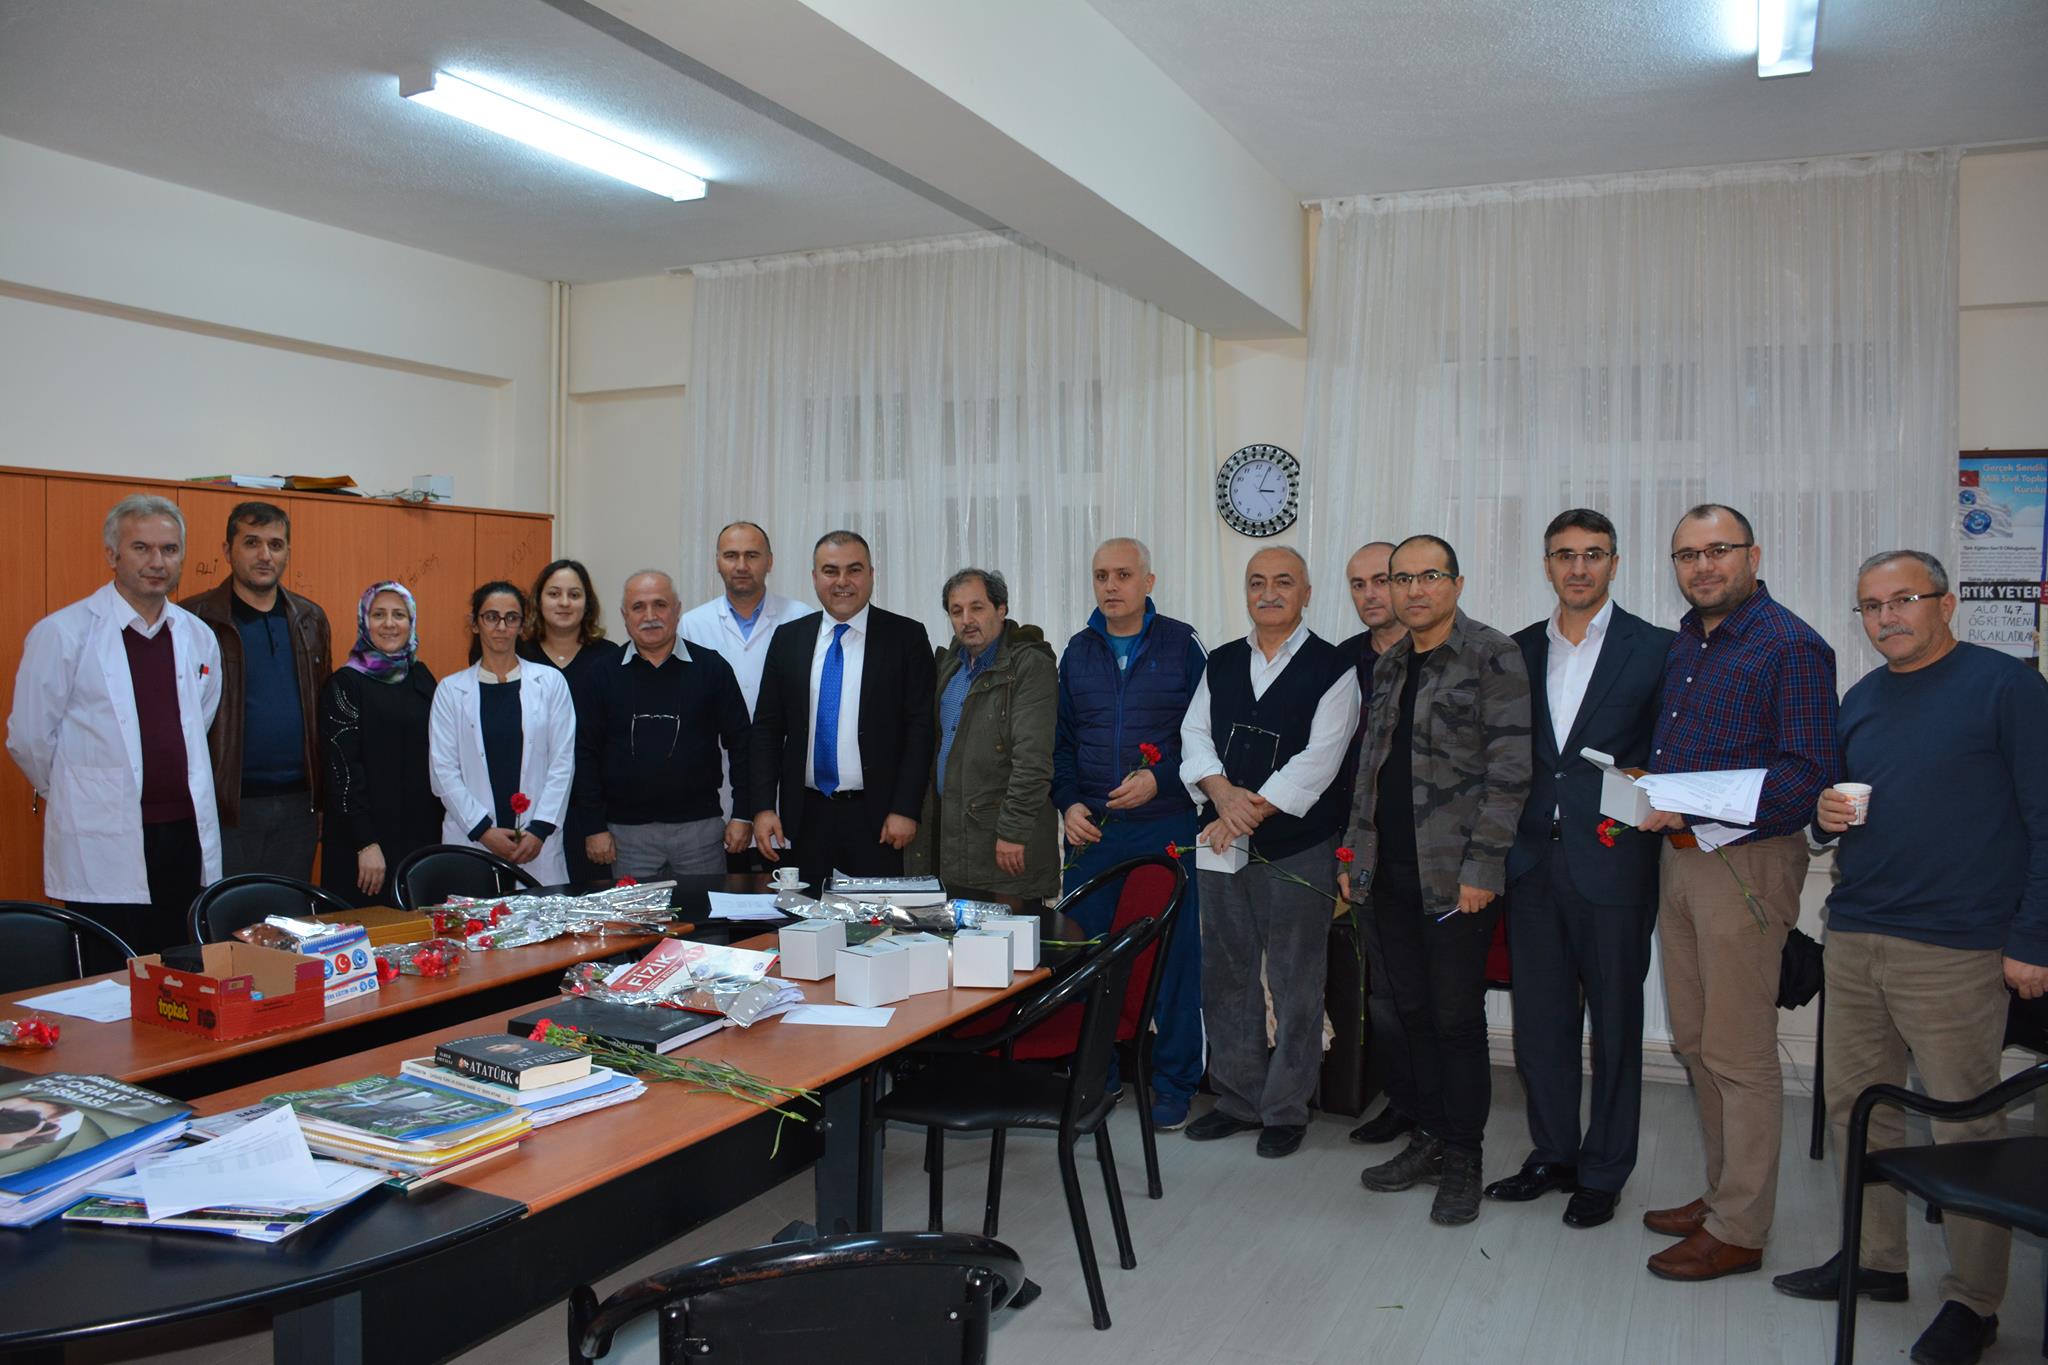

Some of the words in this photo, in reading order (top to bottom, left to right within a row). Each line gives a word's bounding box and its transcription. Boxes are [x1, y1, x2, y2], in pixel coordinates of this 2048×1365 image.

[1997, 586, 2041, 598] YETER
[1974, 605, 1998, 614] ALO
[627, 953, 677, 986] FİZİK
[158, 998, 189, 1021] topkek
[469, 1060, 514, 1084] ATATÜRK
